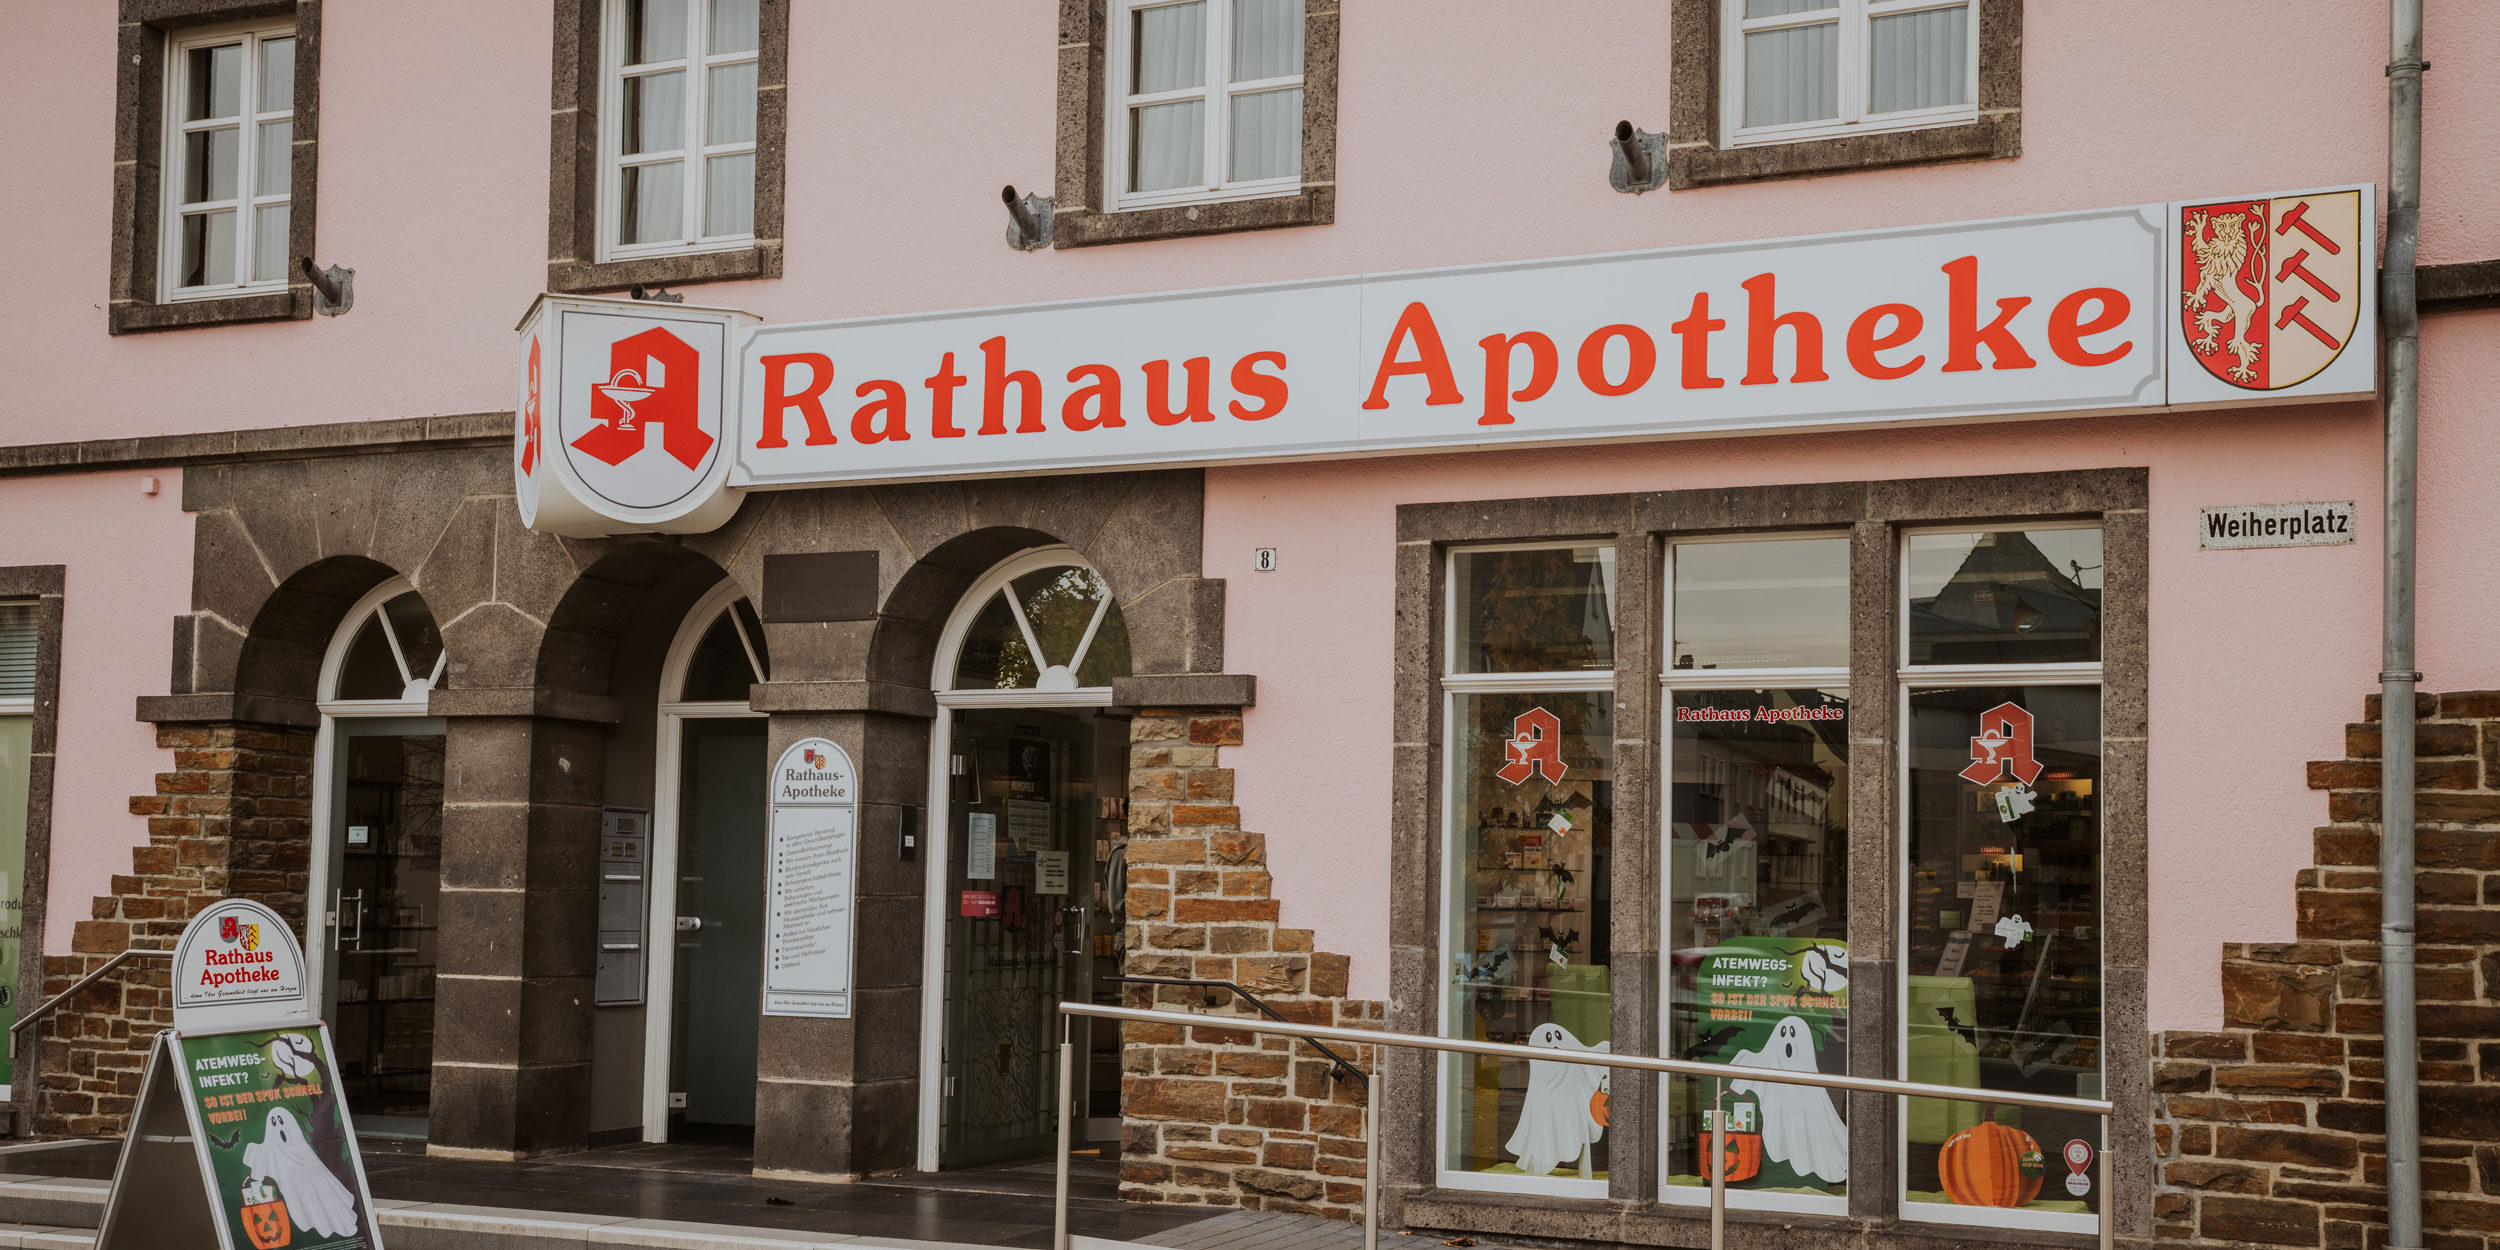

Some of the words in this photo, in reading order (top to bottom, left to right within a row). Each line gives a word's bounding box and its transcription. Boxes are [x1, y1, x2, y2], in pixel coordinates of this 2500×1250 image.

[757, 336, 1289, 449] Rathaus
[1362, 256, 2132, 426] Apotheke
[2207, 509, 2348, 539] Weiherplatz
[1261, 550, 1270, 569] 8
[1677, 706, 1751, 722] Rathaus
[1754, 705, 1843, 724] Apotheke
[786, 769, 844, 781] Rathaus-
[782, 785, 845, 800] Apotheke
[205, 948, 273, 966] Rathaus
[1713, 957, 1794, 971] ATEMWEGS-
[200, 966, 280, 988] Apotheke
[1712, 974, 1768, 988] INFEKT?
[1710, 992, 1725, 1005] SO
[1728, 992, 1745, 1006] IST
[1746, 994, 1766, 1006] DER
[1769, 994, 1797, 1008] SPUK
[1800, 996, 1847, 1009] SCHNELL
[196, 1053, 266, 1071] ATEMWEGS-
[199, 1072, 249, 1088] INFEKT?
[204, 1096, 218, 1109] SO
[219, 1094, 234, 1108] IST
[235, 1092, 254, 1105] DER
[255, 1088, 282, 1104] SPUK
[282, 1083, 323, 1098] SCHNELL
